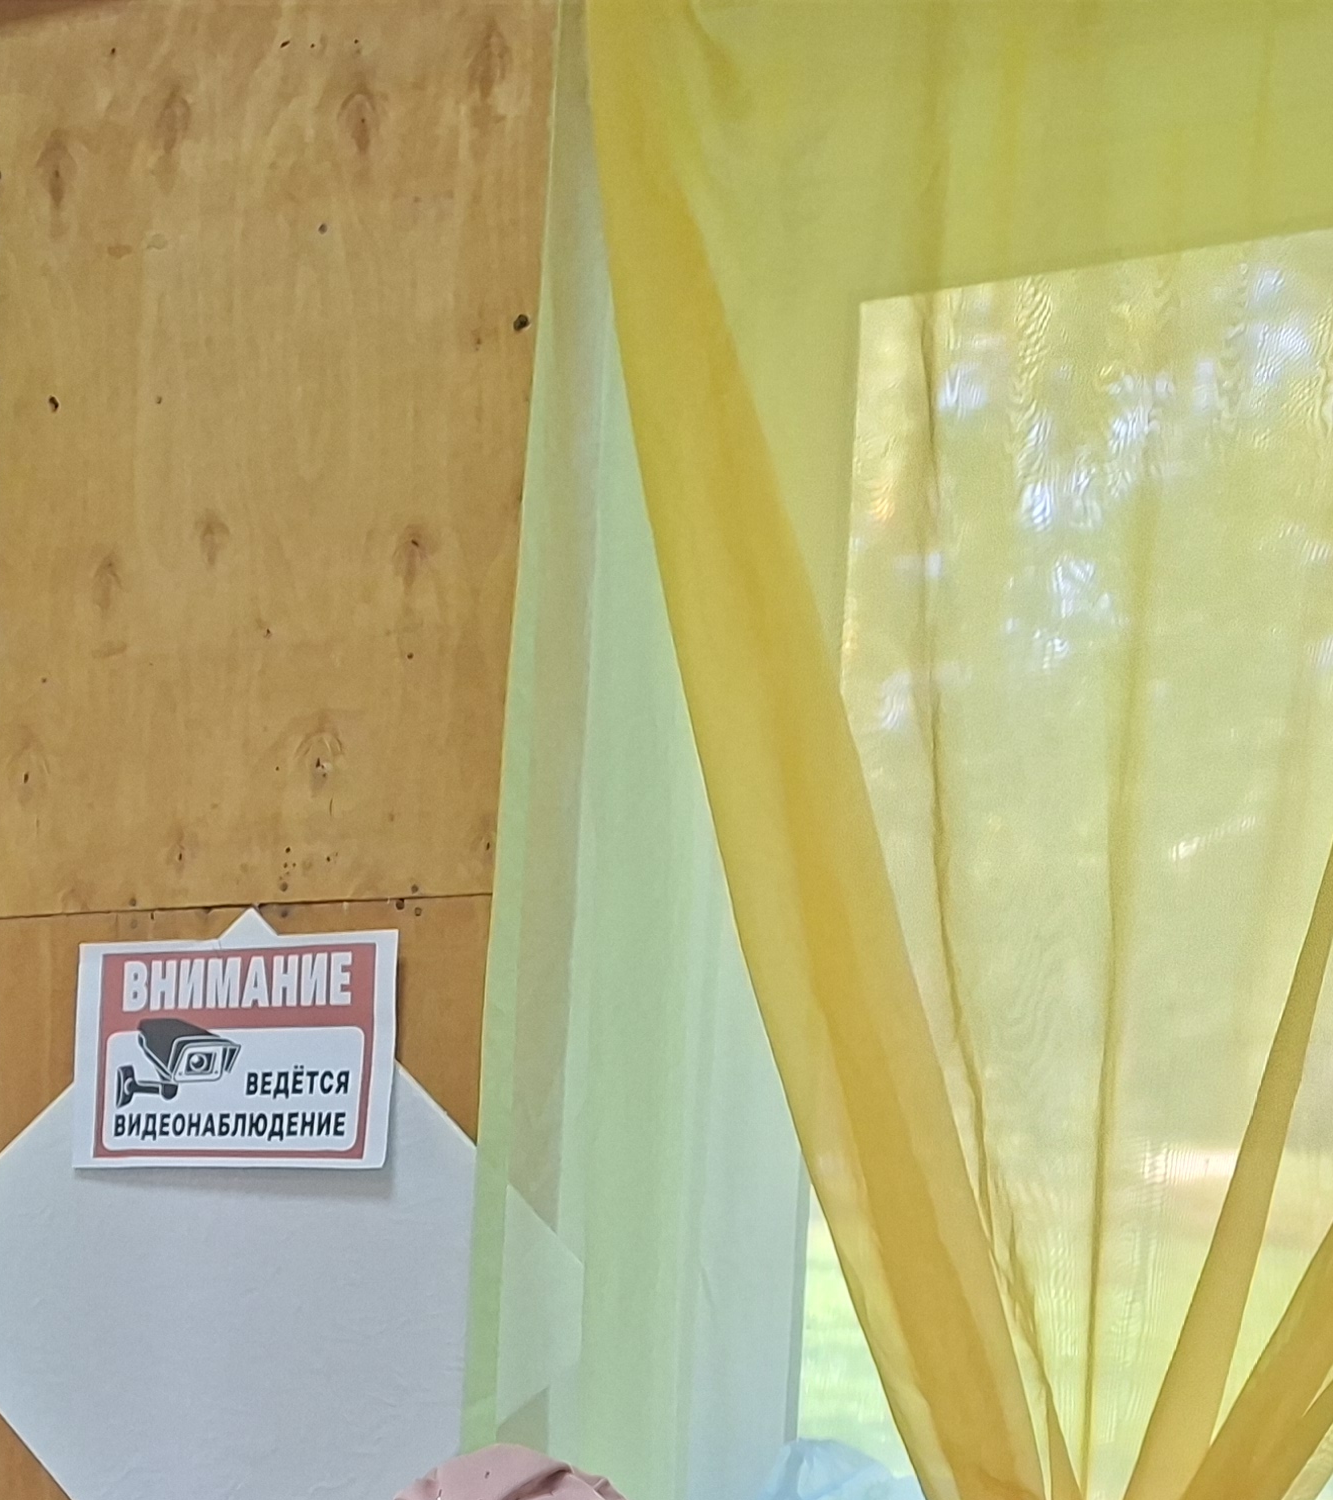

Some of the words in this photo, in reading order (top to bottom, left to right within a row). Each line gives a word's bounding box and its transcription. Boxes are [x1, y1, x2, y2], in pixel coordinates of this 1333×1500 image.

[121, 951, 353, 1013] ВНИМАНИЕ
[245, 1065, 351, 1100] ВЕДЁТСЯ
[113, 1111, 347, 1142] ВИДЕОНАБЛЮДЕНИЕ
